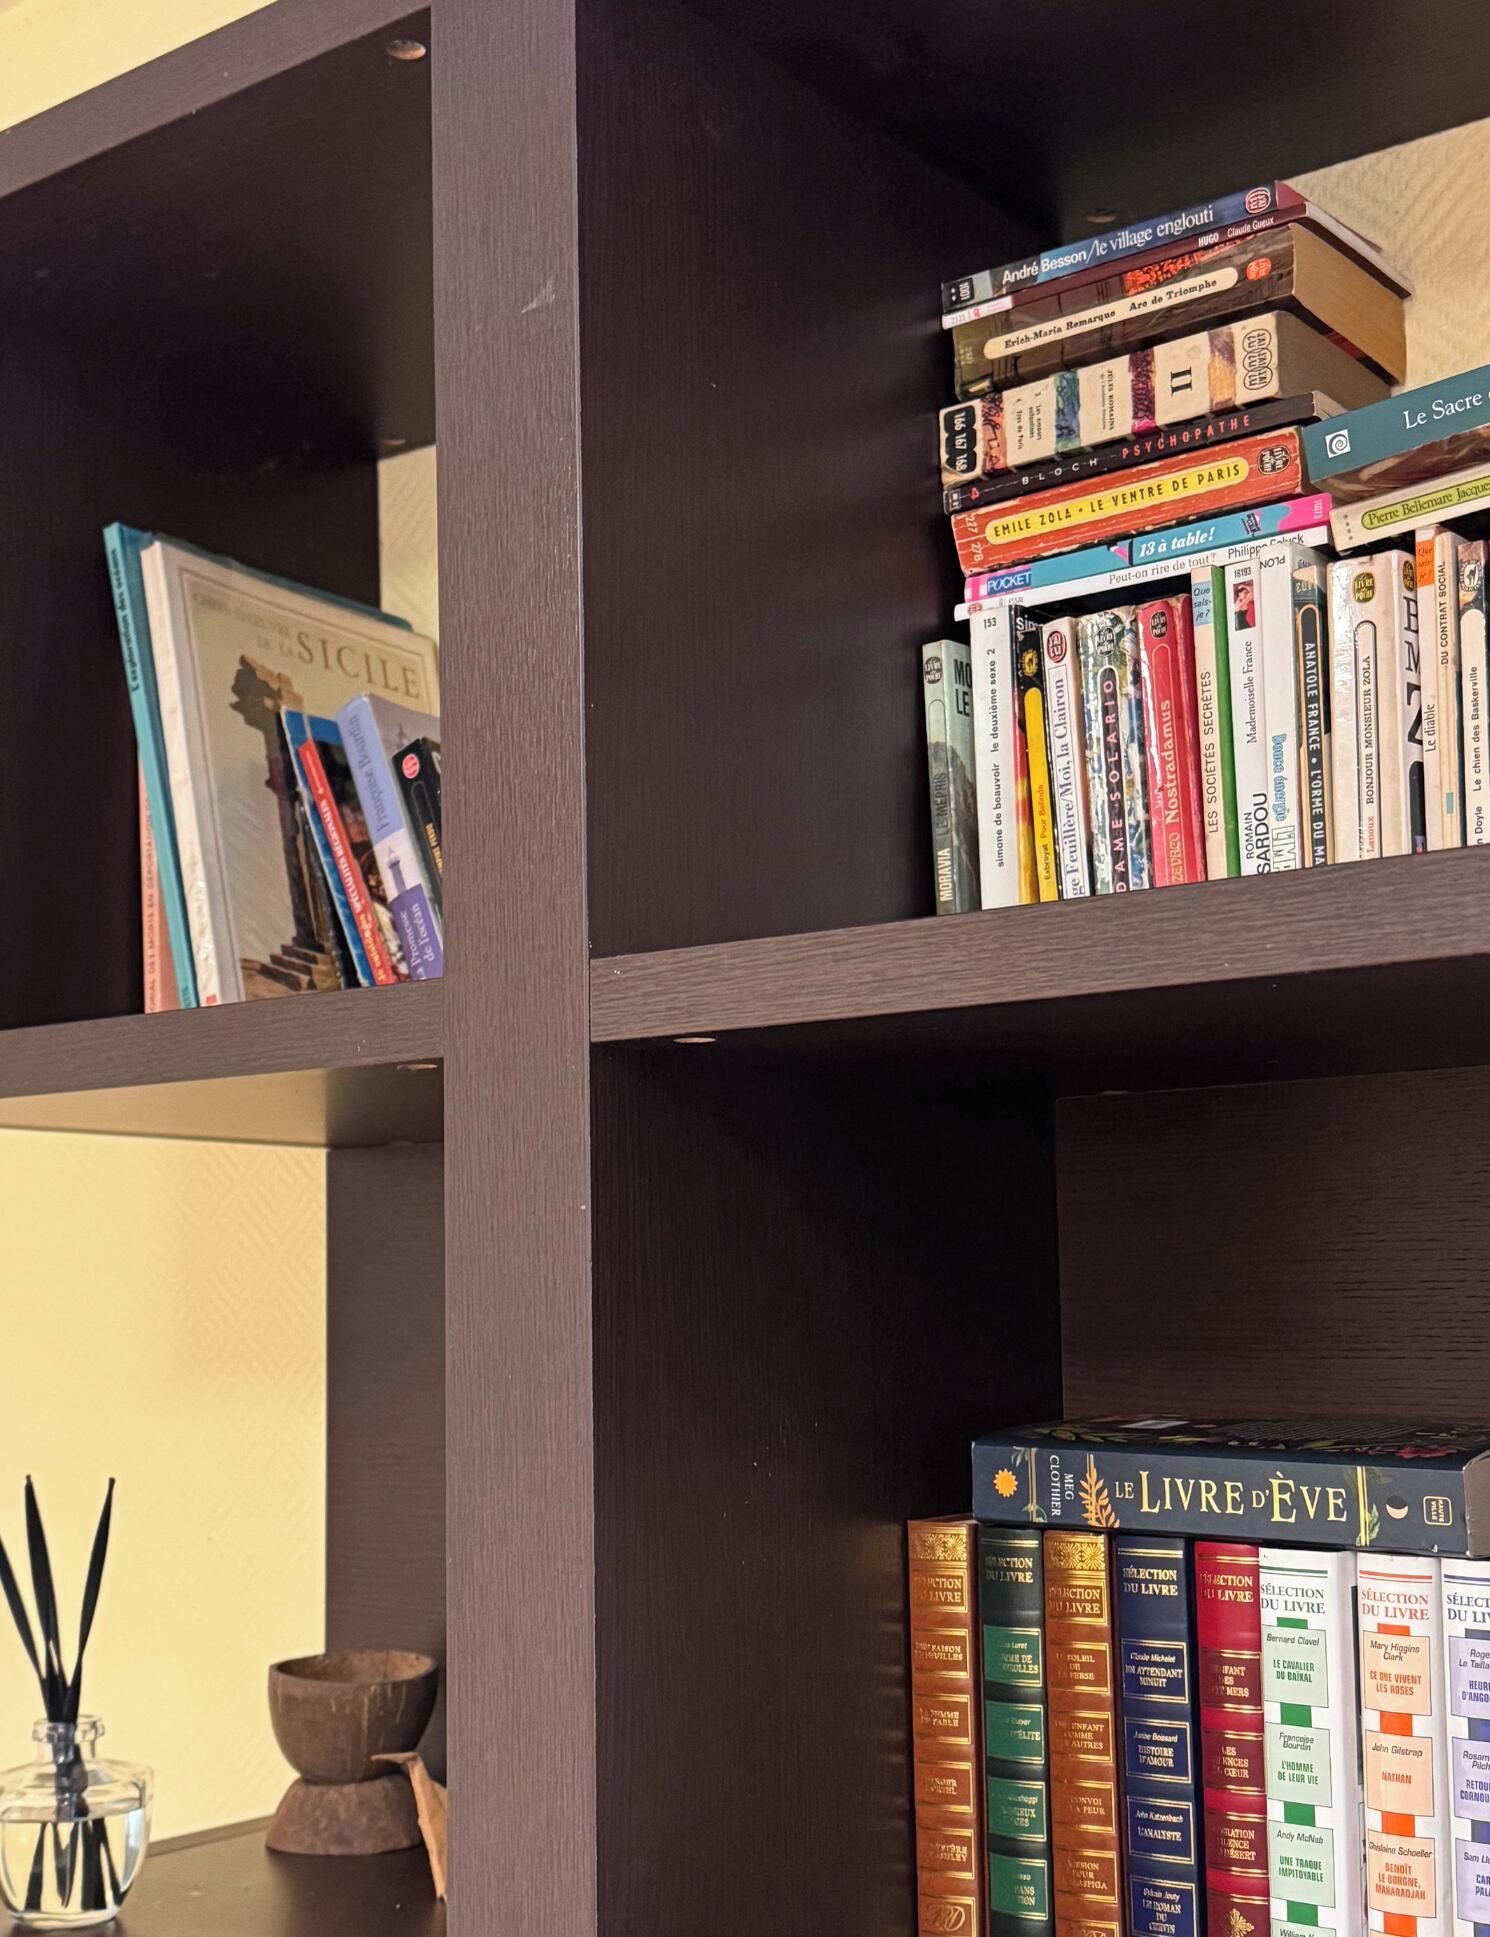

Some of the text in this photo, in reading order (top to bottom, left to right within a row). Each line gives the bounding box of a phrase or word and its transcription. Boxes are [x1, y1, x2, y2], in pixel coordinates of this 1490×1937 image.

[1198, 217, 1275, 248] HUGO Claude Gueux
[1002, 205, 1214, 285] André village englouti
[958, 281, 972, 301] 1001
[1004, 278, 1217, 348] Erich-Maria Remarque Arc de Triomphe
[1170, 366, 1193, 397] II
[1403, 393, 1483, 430] Le Sacre
[953, 411, 968, 472] 166 167 168
[1121, 414, 1250, 459] PSYCHOPATHE
[1273, 447, 1285, 470] LIVRE
[1021, 457, 1099, 485] BLOCH
[994, 464, 1241, 537] EMILE ZOLA LE VENTRE DE PARIS
[1368, 494, 1453, 526] Pierre Bellemare
[1139, 526, 1216, 557] 13 à table!
[1259, 554, 1286, 570] PLON
[1109, 559, 1186, 585] Peut-on rire de
[1234, 566, 1252, 579] 16193
[987, 571, 1031, 593] POCKET
[1354, 578, 1374, 589] LIVRE
[1193, 587, 1211, 597] Que
[1193, 598, 1212, 609] sais-
[1437, 561, 1449, 665] DU CONTRAT SOCIAL
[983, 617, 997, 629] 153
[987, 648, 996, 656] 2
[297, 630, 420, 699] SICILE
[1242, 640, 1257, 744] Mademoiselle France
[1469, 665, 1480, 721] Baskerville
[955, 689, 970, 717] LE
[988, 688, 999, 740] deuxième
[1053, 678, 1071, 759] la Clairon
[1424, 703, 1437, 753] Le diable
[1471, 724, 1480, 743] des
[348, 714, 371, 770] Bourdin
[990, 741, 999, 753] le
[1103, 680, 1121, 800] SOLARIO
[1305, 643, 1325, 840] ANATOLE FRANCE L'ORME DU
[1200, 671, 1219, 833] LES SOCIÉTÉS SECRÈTES
[1272, 732, 1287, 774] Douce
[1362, 655, 1375, 853] Lanoux BONJOUR MONSIEUR ZOLA
[1472, 746, 1481, 775] chien
[1160, 700, 1179, 825] Nostradamus
[992, 763, 1001, 811] beauvoir
[1473, 778, 1482, 792] Le
[993, 813, 1002, 826] de
[1039, 819, 1047, 839] Pour
[1474, 805, 1485, 834] Doyle
[1244, 811, 1255, 860] ROMAIN
[1252, 792, 1271, 874] SARDOU
[994, 829, 1004, 868] simone
[936, 848, 953, 902] MORAVIA
[400, 910, 421, 968] Promesse
[412, 902, 435, 963] de l'océan
[1049, 1454, 1062, 1517] CLOTHIER
[1064, 1473, 1075, 1501] MEG
[1115, 1469, 1348, 1524] LE LIVRE D'ÈVE
[1122, 1564, 1178, 1581] SÉLECTION
[1123, 1582, 1179, 1596] DU LIVRE
[1217, 1589, 1254, 1603] LIVRE
[1260, 1582, 1325, 1599] SÉLECTION
[1360, 1587, 1429, 1606] SÉLECTION
[1261, 1598, 1326, 1614] DU LIVRE
[1361, 1603, 1430, 1621] DU LIVRE
[1448, 1608, 1467, 1622] DU
[1266, 1632, 1320, 1646] Bernard Clavel
[1370, 1640, 1420, 1655] Mary Higgins
[1273, 1659, 1315, 1671] LE CAVALIER
[1383, 1651, 1404, 1662] Clark
[1137, 1666, 1183, 1678] ATTENDANT
[1139, 1675, 1168, 1687] MINUIT
[1276, 1670, 1313, 1683] DU BAÏKAL
[1369, 1670, 1422, 1685] CE QUE VIVENT
[1376, 1681, 1415, 1696] LES ROSES
[1138, 1745, 1174, 1757] HISTOIRE
[1282, 1740, 1312, 1752] Bourdin
[1371, 1743, 1423, 1758] John Gilstrap
[1281, 1759, 1314, 1773] L'HOMME
[1277, 1770, 1319, 1785] DE LEUR VIE
[1381, 1771, 1412, 1785] NATHAN
[1138, 1827, 1182, 1842] L'ANALYSTE
[1276, 1829, 1324, 1845] Andy McNab
[1368, 1841, 1433, 1859] Ghislaine Schoeller
[1463, 1851, 1480, 1864] Sam
[1279, 1855, 1323, 1871] UNE TRAQUE
[1384, 1861, 1413, 1874] BENOÎT
[1278, 1867, 1324, 1883] IMPITOYABLE
[1378, 1871, 1422, 1889] LE BORGNE,
[1375, 1883, 1426, 1900] MAHARADJAH
